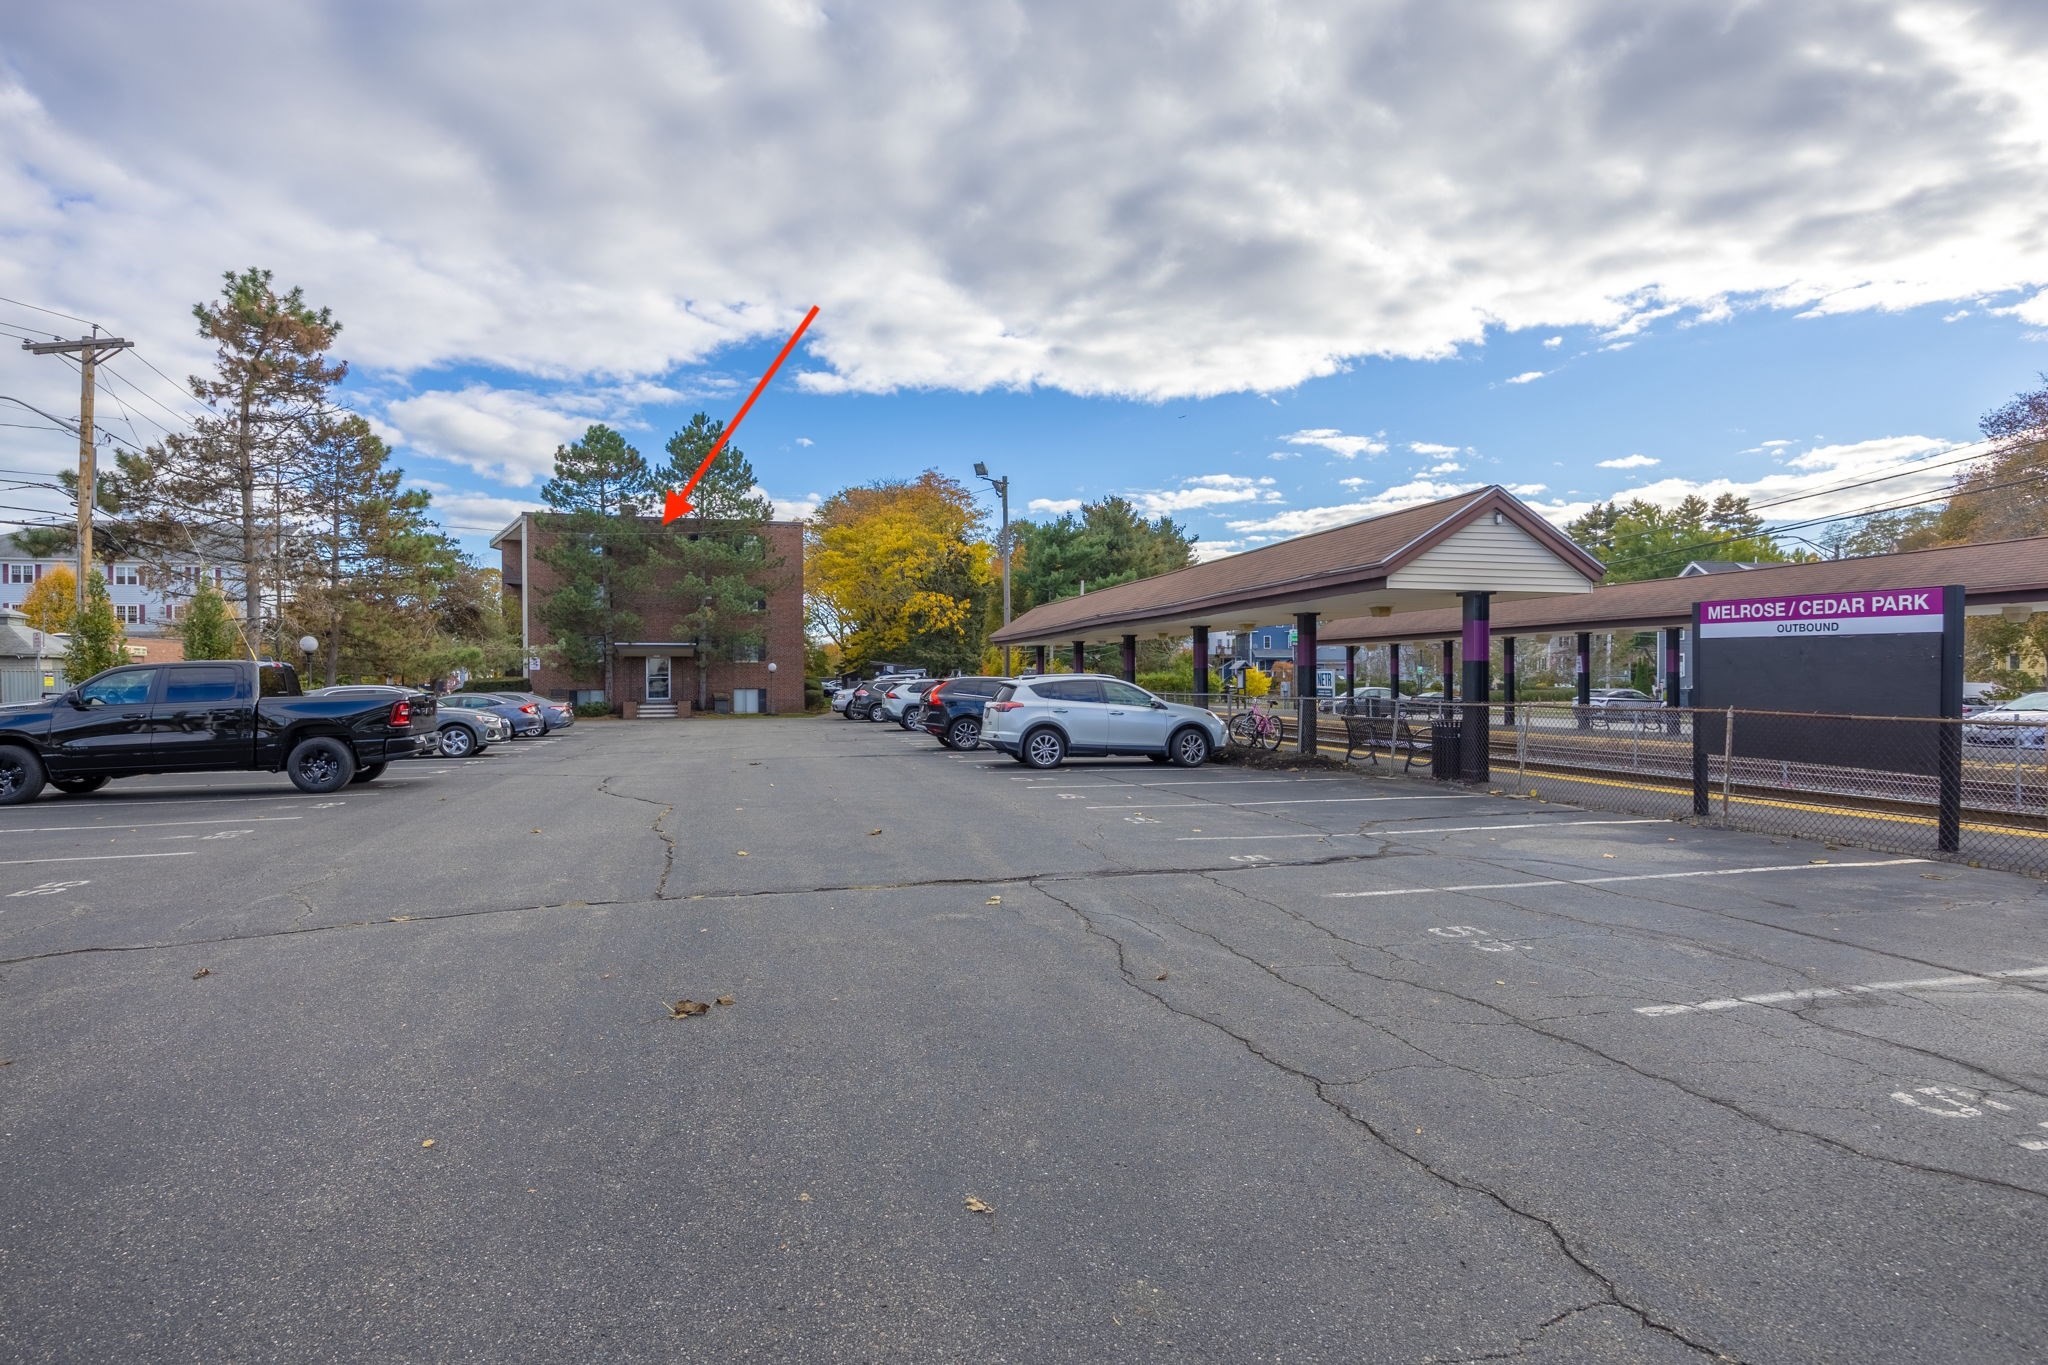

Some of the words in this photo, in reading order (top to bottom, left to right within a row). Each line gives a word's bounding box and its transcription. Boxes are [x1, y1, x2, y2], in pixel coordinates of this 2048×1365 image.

[1708, 602, 1786, 620] MELROSE
[1799, 597, 1865, 616] CEDAR
[1871, 593, 1930, 612] PARK
[1776, 622, 1840, 633] OUTBOUND
